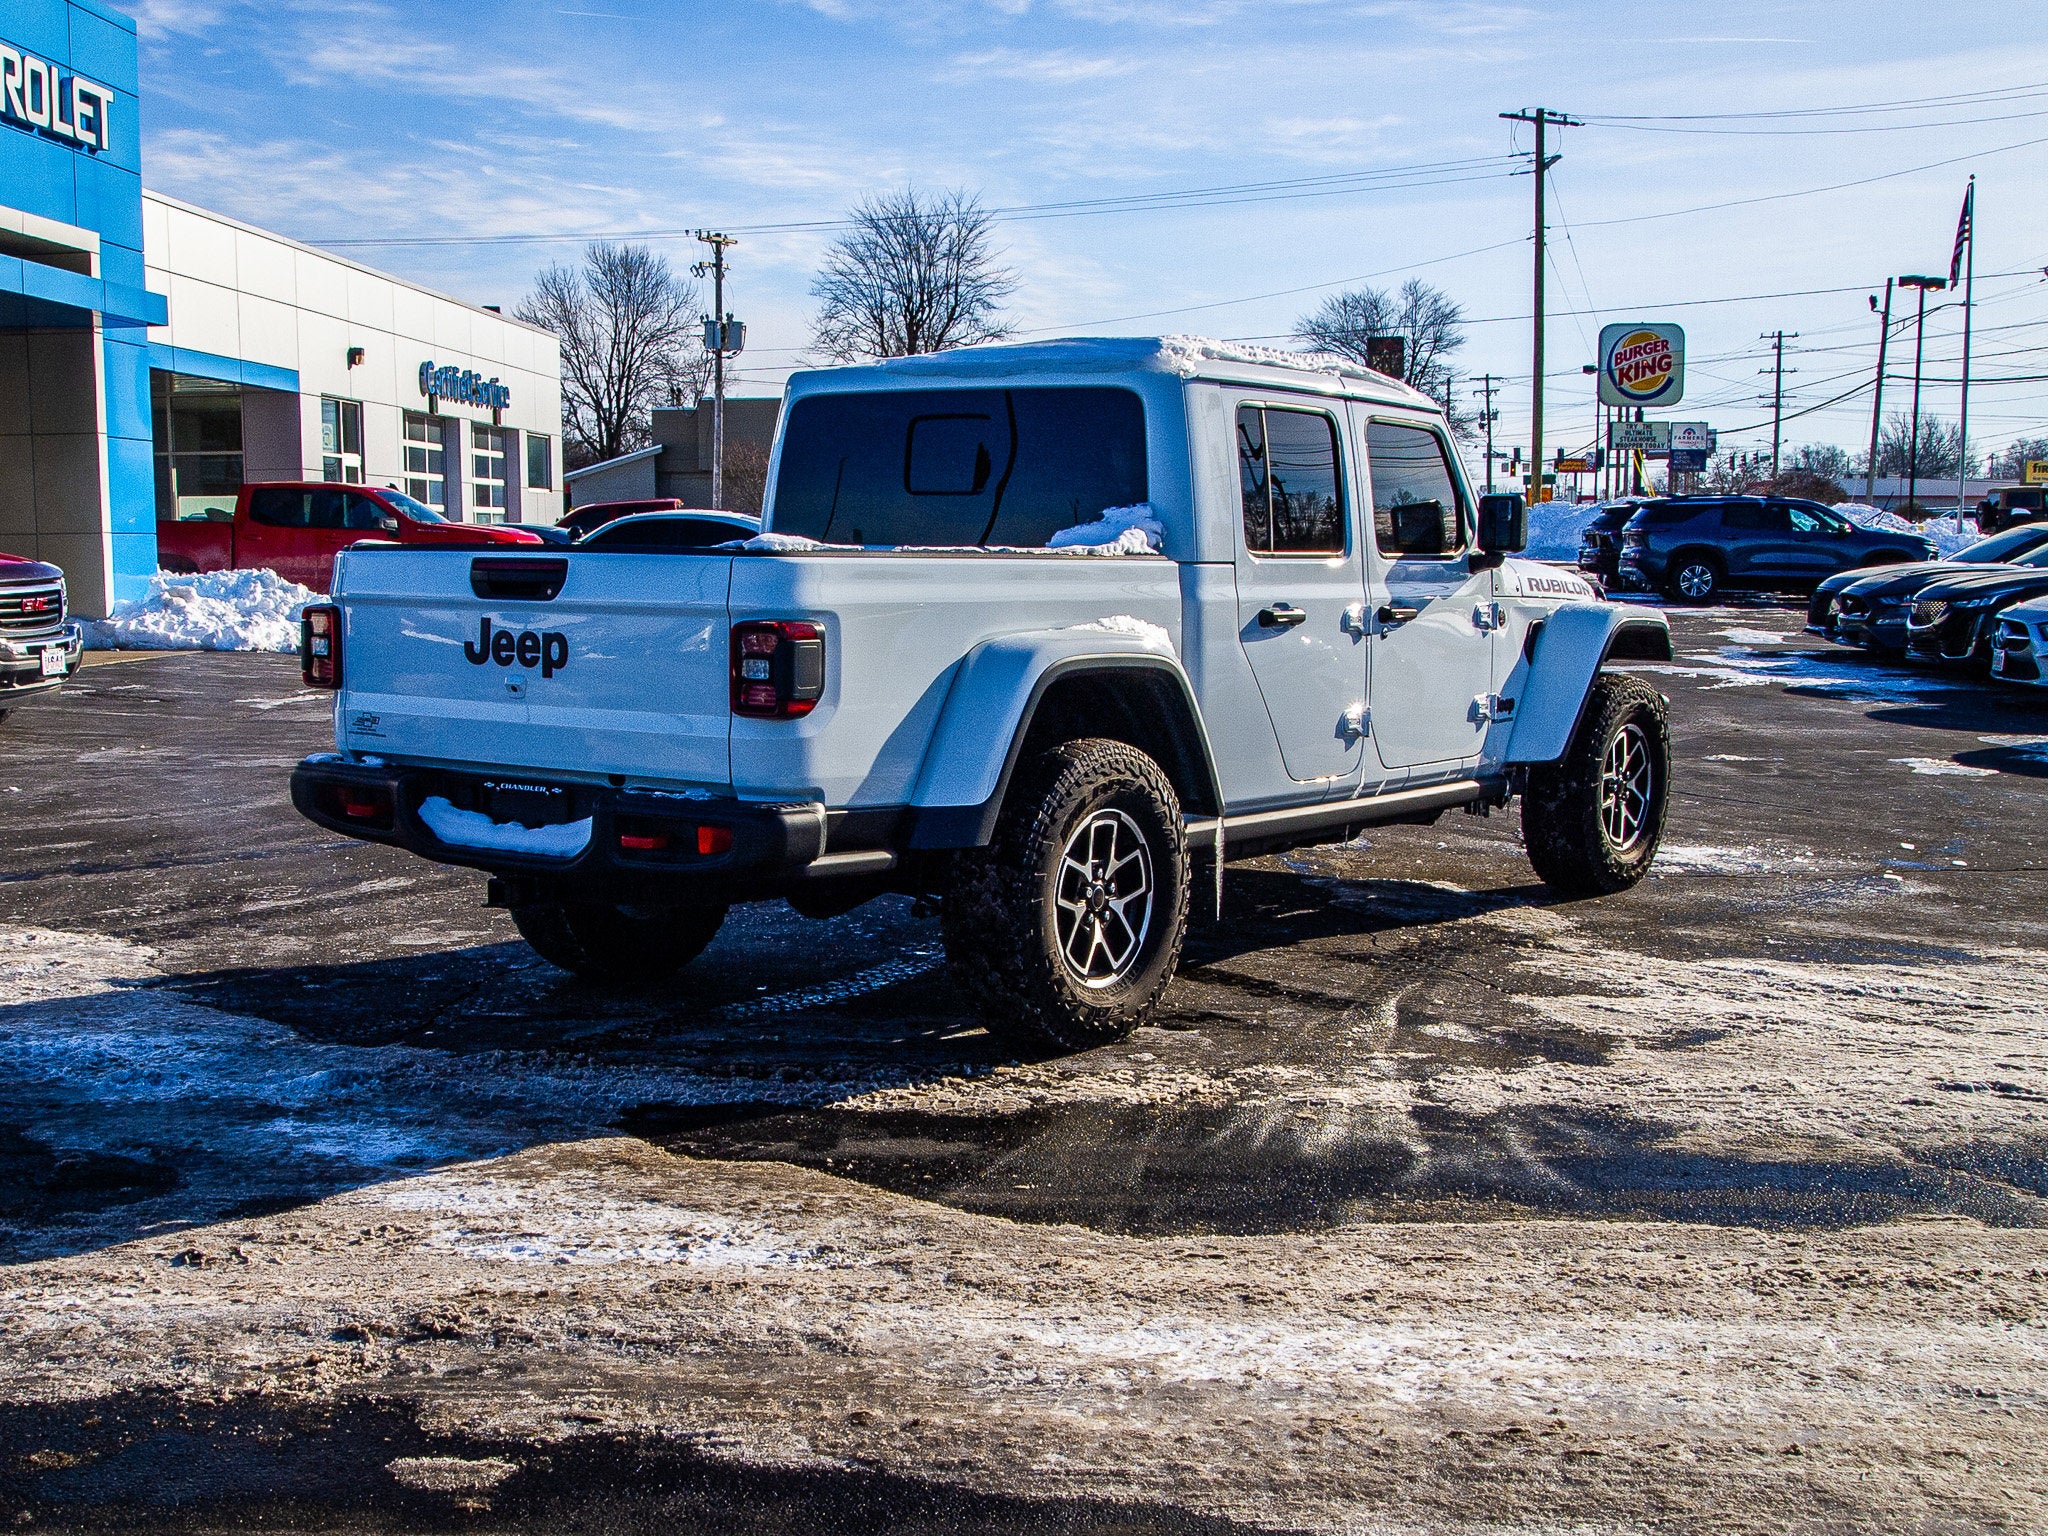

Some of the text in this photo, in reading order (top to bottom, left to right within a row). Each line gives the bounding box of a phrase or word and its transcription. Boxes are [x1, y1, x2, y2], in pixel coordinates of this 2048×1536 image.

[0, 43, 116, 151] ROLET
[1614, 339, 1670, 367] BURGER
[1617, 353, 1672, 386] KING
[420, 360, 510, 408] Certified Service
[1526, 577, 1592, 598] RUBICON
[463, 617, 569, 679] Jeep
[500, 782, 547, 793] CHANDLER
